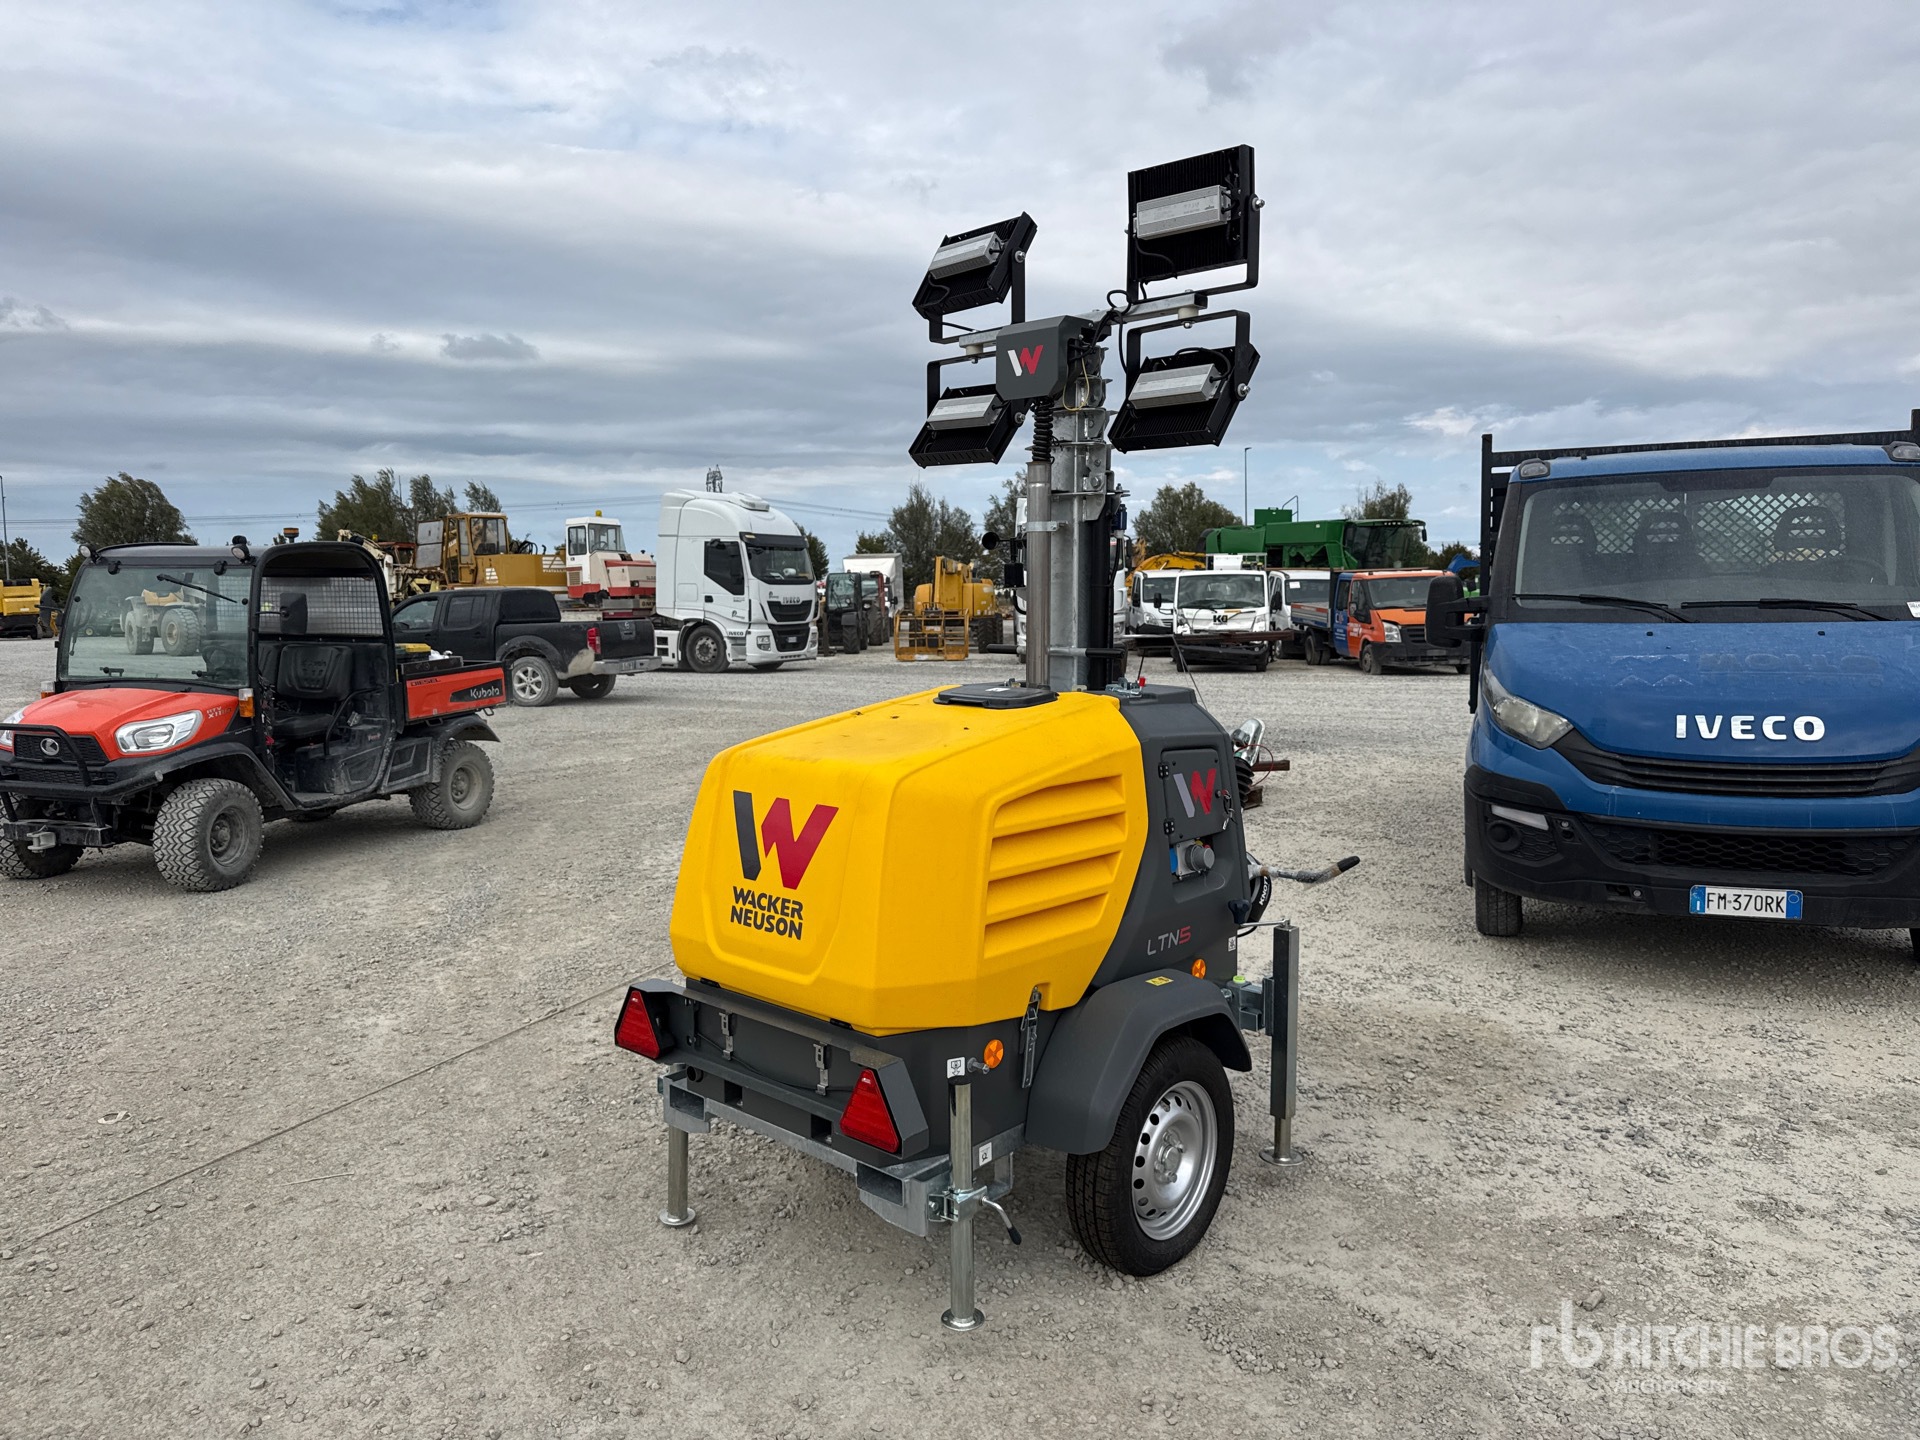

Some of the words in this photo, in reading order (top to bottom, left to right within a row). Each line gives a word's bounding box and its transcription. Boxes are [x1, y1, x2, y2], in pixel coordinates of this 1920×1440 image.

[782, 596, 801, 605] IVECO
[410, 678, 441, 687] DIESEL
[470, 686, 501, 699] Kubota
[1675, 714, 1826, 741] IVECO
[733, 886, 804, 921] WACKER
[730, 905, 803, 941] NEUSON
